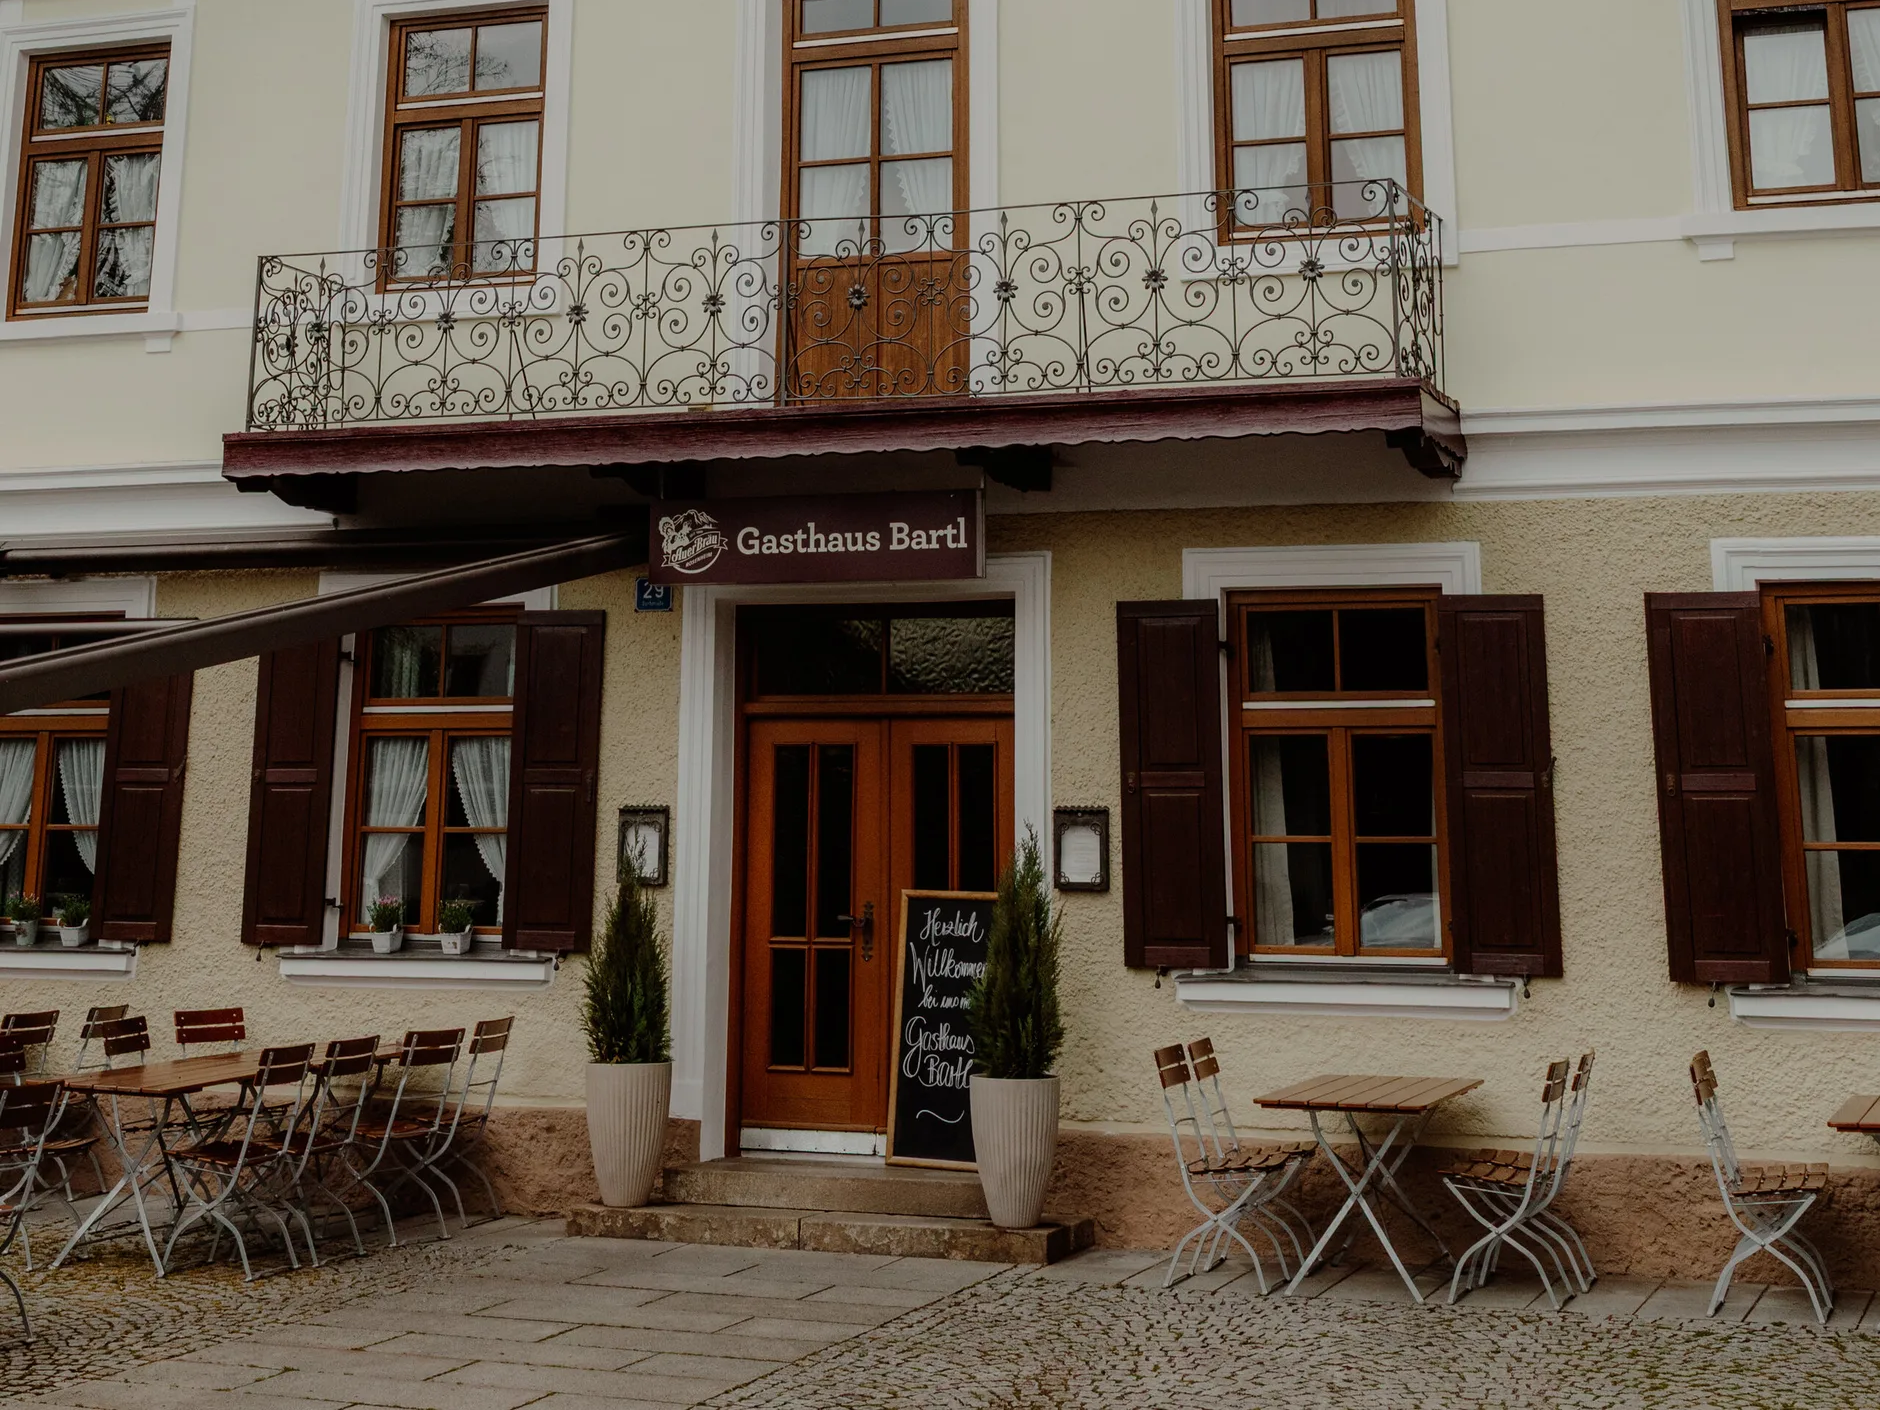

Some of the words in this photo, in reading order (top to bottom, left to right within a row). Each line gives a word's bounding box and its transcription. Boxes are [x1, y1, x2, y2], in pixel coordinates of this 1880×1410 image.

[737, 522, 880, 555] Gasthaus
[889, 517, 967, 551] Bartl
[643, 581, 664, 599] 29
[920, 907, 984, 947] Herzlich
[918, 984, 939, 1009] bei
[902, 1015, 976, 1078] Gasthaus
[918, 1053, 974, 1089] Bartl
